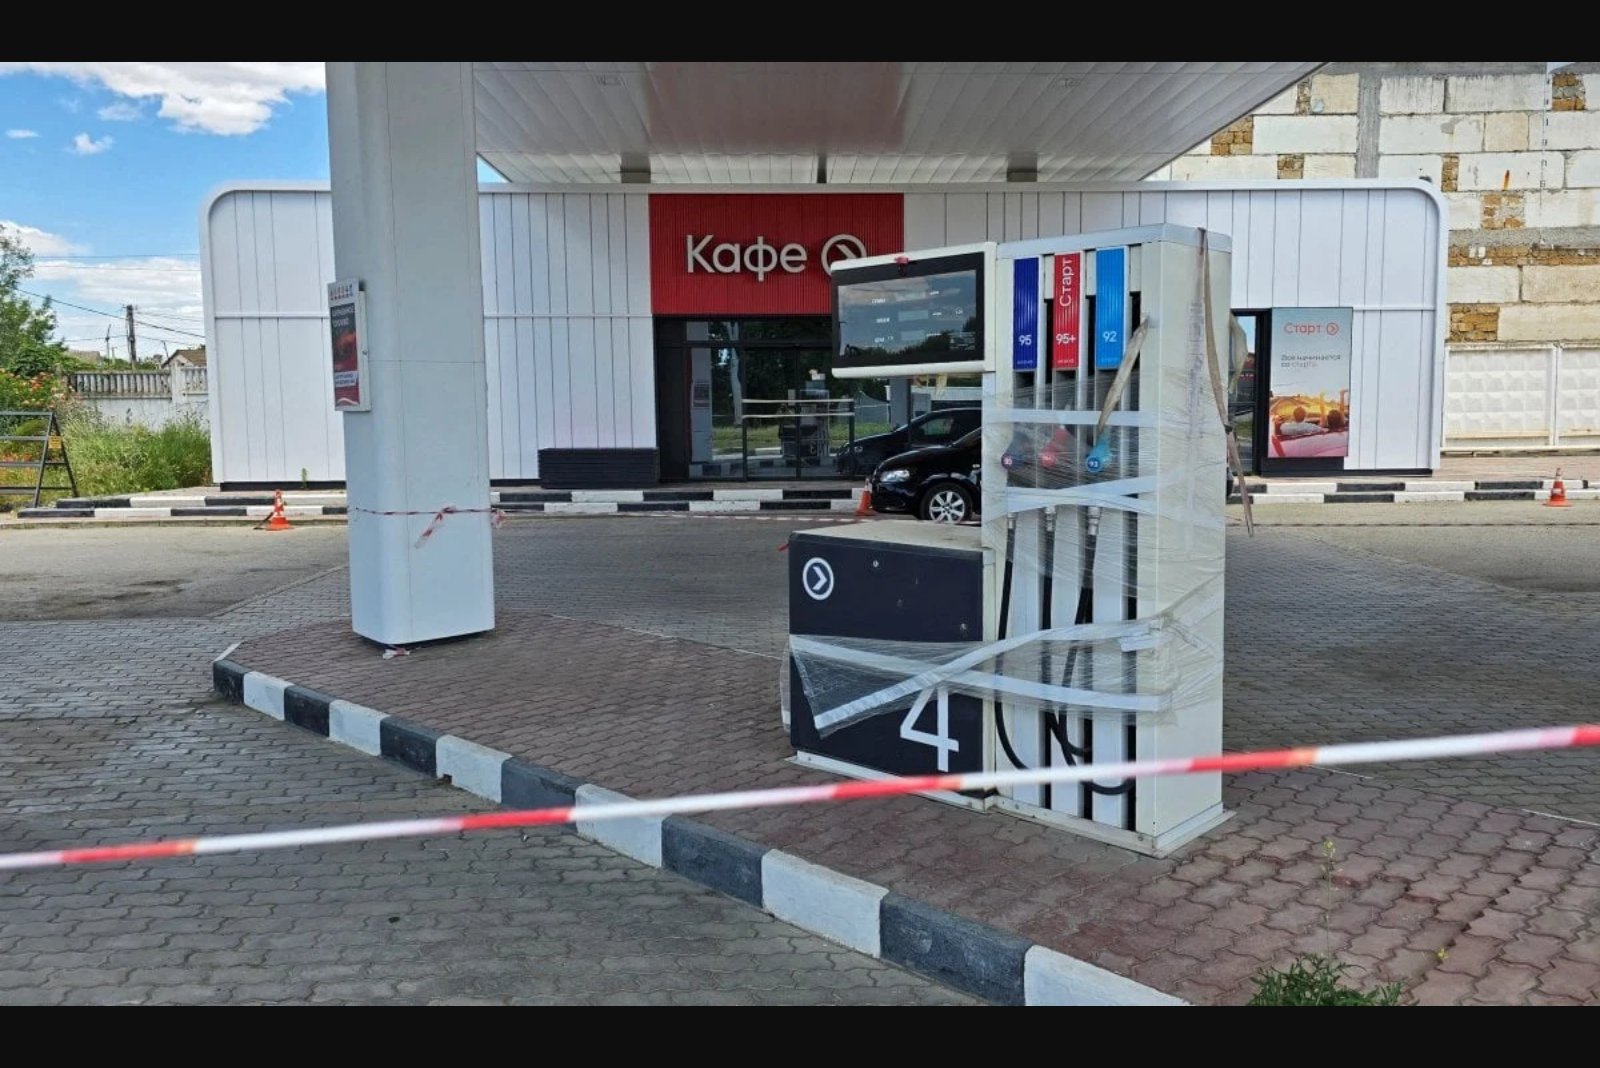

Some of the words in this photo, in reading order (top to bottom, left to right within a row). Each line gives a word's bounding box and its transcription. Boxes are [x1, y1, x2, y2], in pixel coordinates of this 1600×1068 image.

[686, 234, 808, 282] Кафе
[1059, 257, 1074, 307] Старт
[1284, 322, 1321, 335] Старт
[1018, 334, 1033, 346] 95
[1055, 332, 1077, 345] 95+
[1102, 330, 1118, 343] 92
[900, 686, 960, 773] 4
